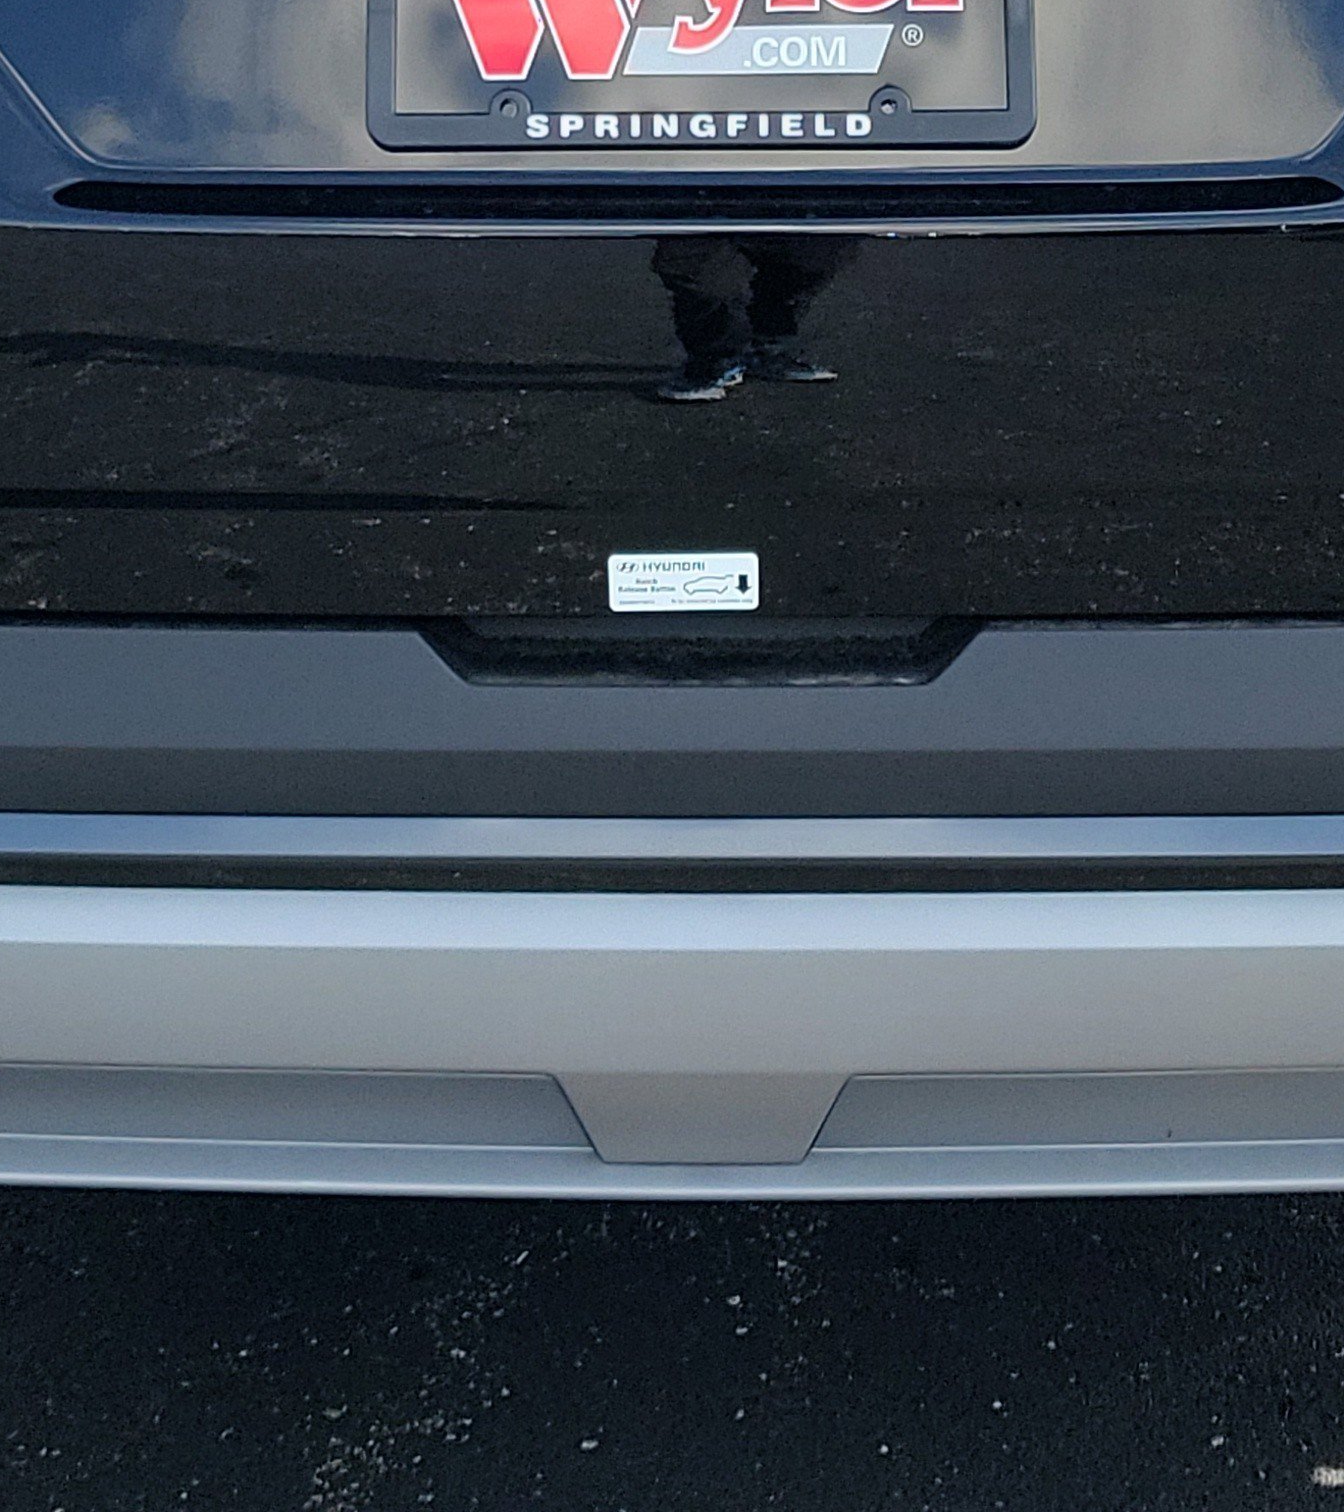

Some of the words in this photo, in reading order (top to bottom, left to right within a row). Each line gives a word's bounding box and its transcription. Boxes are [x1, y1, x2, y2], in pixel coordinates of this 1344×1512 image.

[743, 36, 847, 68] .COM
[526, 113, 872, 138] SPRINGFIELD
[643, 561, 705, 571] HYUNDAI
